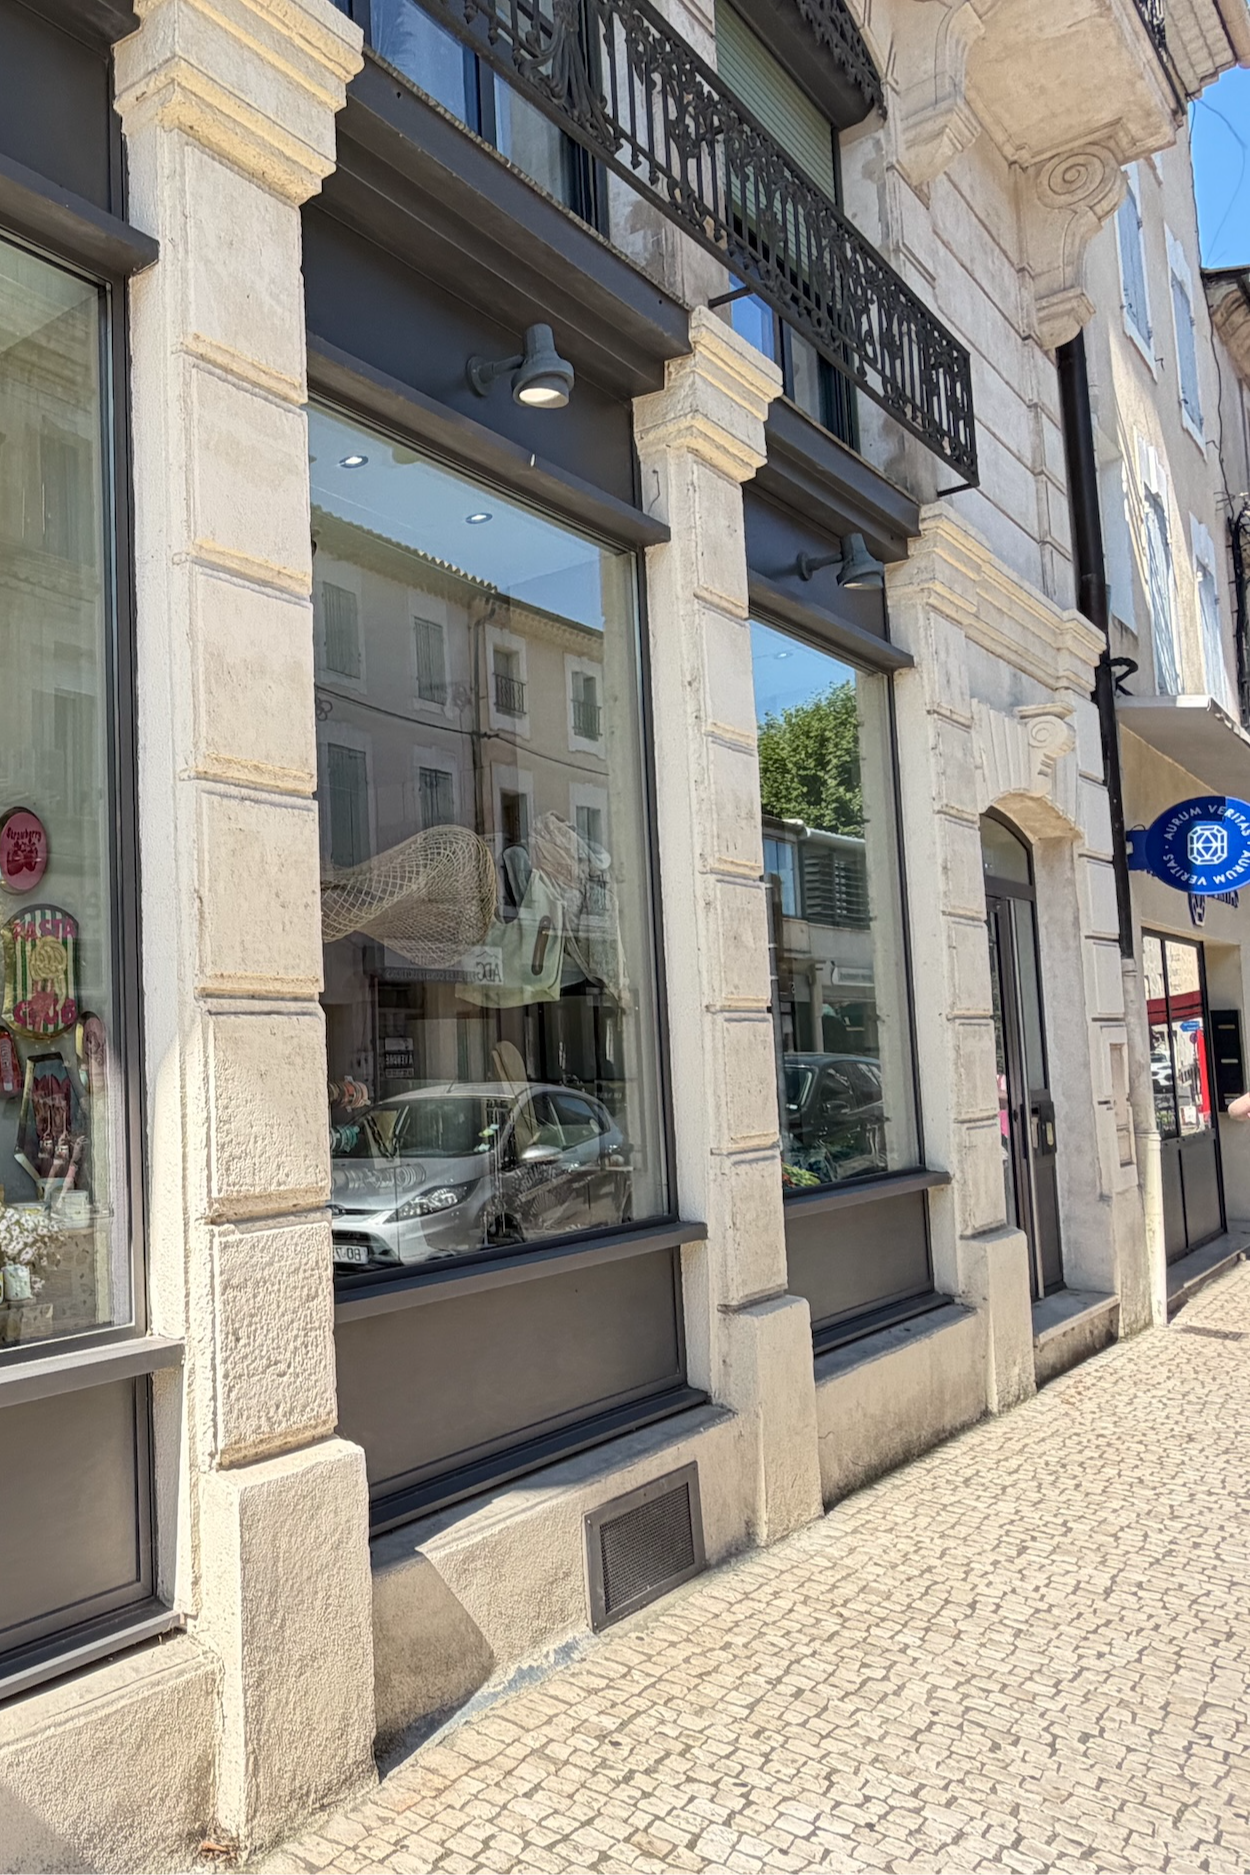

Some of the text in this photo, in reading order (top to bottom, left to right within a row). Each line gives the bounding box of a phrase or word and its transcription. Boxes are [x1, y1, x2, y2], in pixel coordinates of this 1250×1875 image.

[1163, 805, 1250, 841] AURUM VERITAS
[1163, 849, 1250, 887] AURUM VERITAS
[12, 917, 77, 942] PASTA
[12, 998, 77, 1026] CLUB
